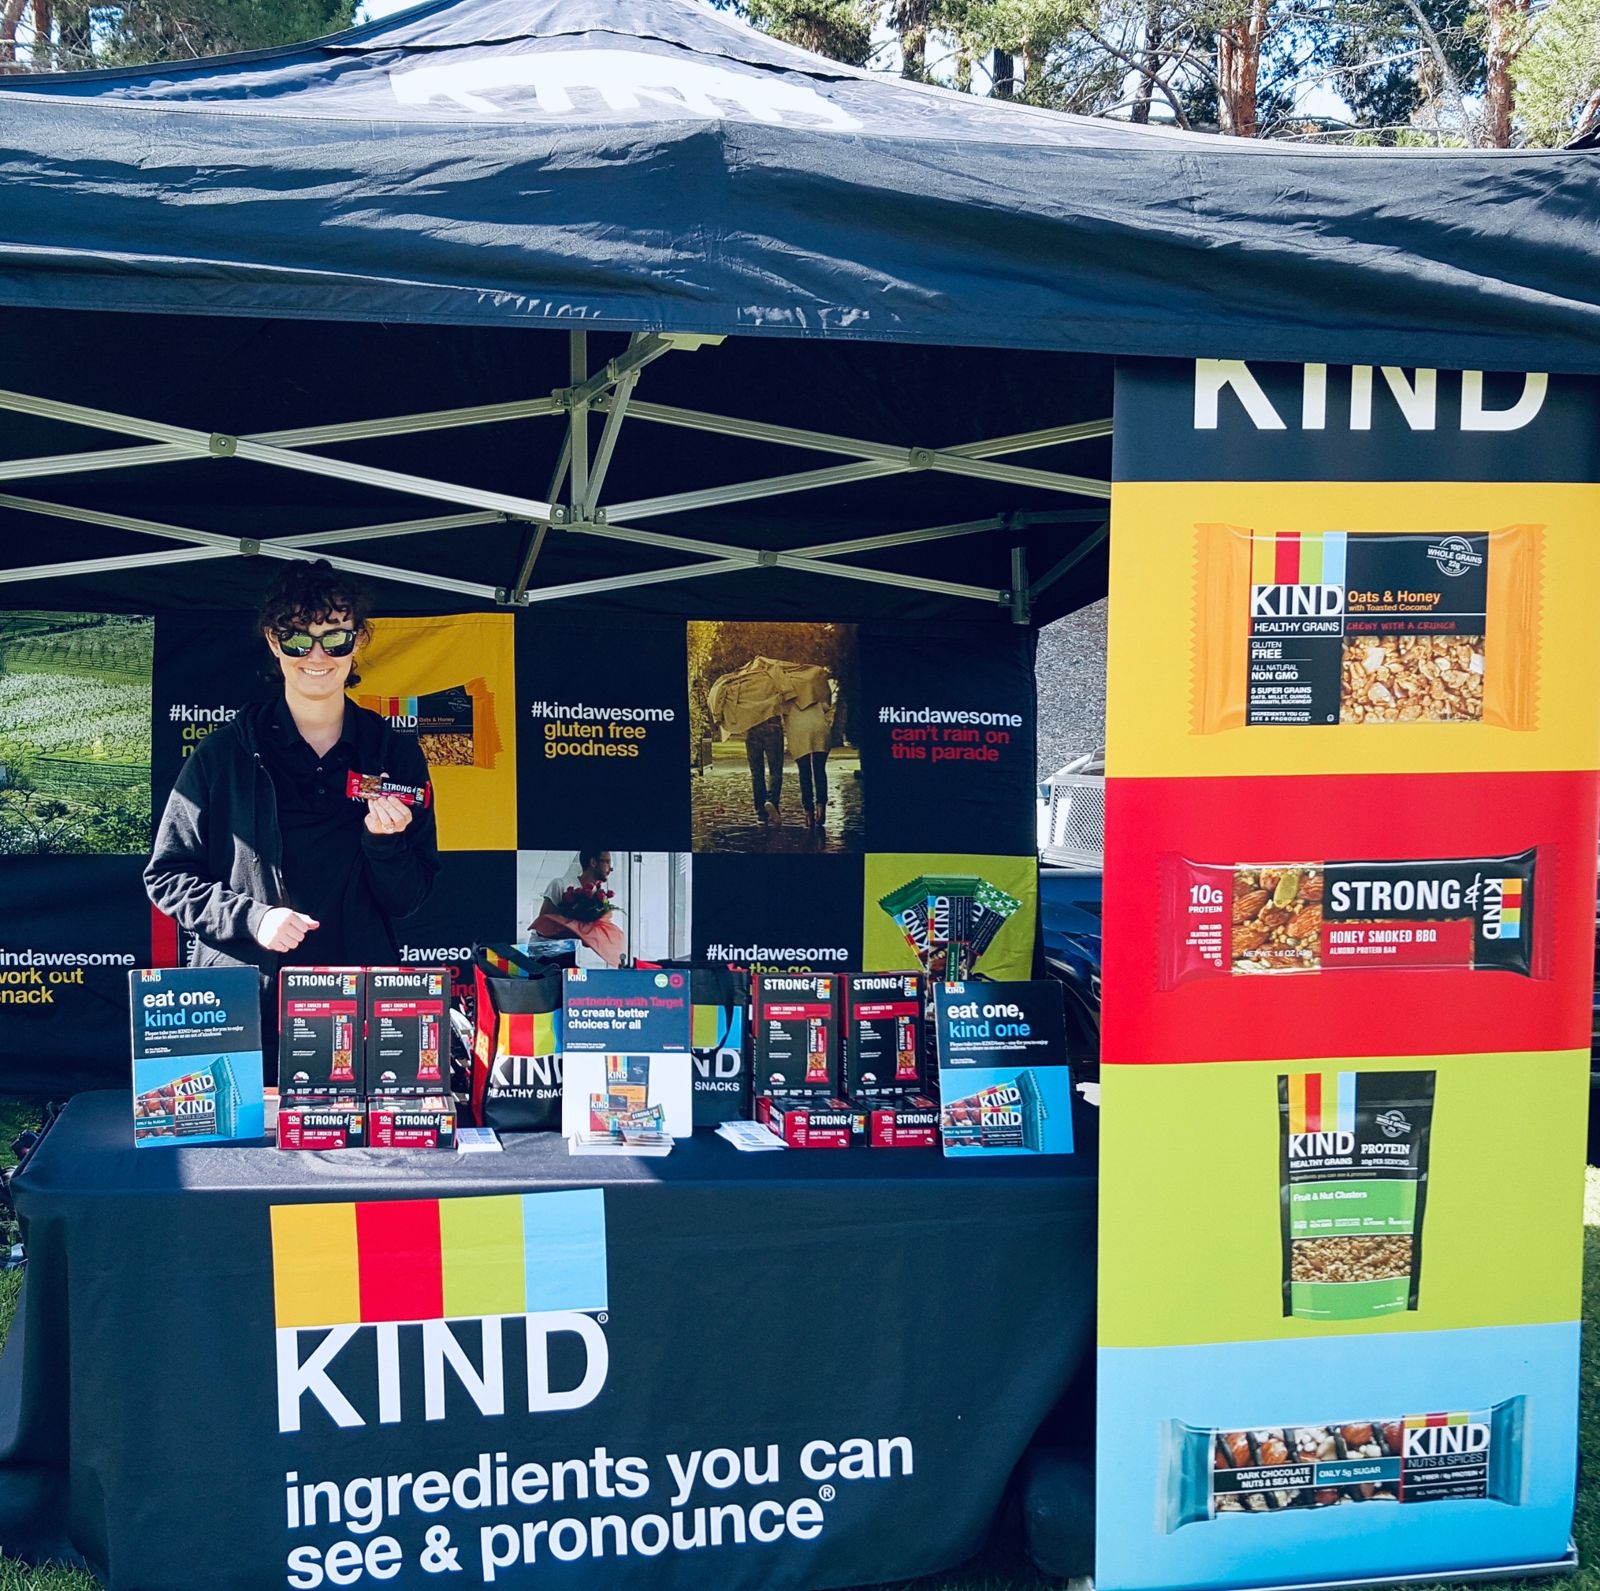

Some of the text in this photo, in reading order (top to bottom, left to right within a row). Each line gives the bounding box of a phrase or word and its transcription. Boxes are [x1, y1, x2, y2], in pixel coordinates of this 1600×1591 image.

[1427, 548, 1483, 564] WHOLE GRAINS
[1251, 584, 1343, 616] KIND
[1347, 590, 1441, 604] Oats & Honey
[1254, 622, 1339, 632] HEALTHY GRAINS
[1382, 622, 1404, 630] WITH
[1417, 621, 1456, 630] CRUNCH
[1252, 649, 1282, 659] FREE
[1251, 671, 1298, 680] NON GMO
[531, 701, 675, 721] #kindawesome
[878, 707, 1023, 727] #kindawesome
[544, 720, 646, 740] gluten free
[891, 725, 1009, 744] can't rain on
[544, 740, 639, 759] goodness
[891, 743, 999, 762] this parade
[382, 782, 411, 793] STRONG
[1190, 884, 1223, 904] 10G
[1330, 872, 1502, 939] STRONG & KIND
[934, 896, 949, 941] KIND
[901, 909, 931, 954] KIND
[1330, 929, 1437, 943] HONEY SMOKED BBQ
[706, 944, 848, 961] #kindawesome
[1356, 946, 1382, 954] PROTEIN
[49, 968, 84, 984] out
[141, 975, 161, 983] KIND
[287, 975, 335, 986] STRONG
[374, 975, 420, 987] STRONG
[567, 974, 587, 982] KIND
[763, 978, 810, 990] STRONG
[853, 977, 896, 991] STRONG
[945, 986, 965, 994] KIND
[0, 986, 54, 1003] nack
[143, 990, 221, 1007] eat one,
[145, 1008, 226, 1027] kind one
[568, 1007, 650, 1018] to create better
[947, 1002, 1024, 1020] eat one,
[568, 1019, 641, 1030] choices for all
[949, 1020, 1030, 1038] kind one
[174, 1074, 213, 1096] KIND
[694, 1081, 740, 1092] SNACKS
[487, 1087, 534, 1098] HEALTHY
[979, 1087, 1020, 1107] KIND
[176, 1099, 215, 1115] KIND
[304, 1115, 343, 1125] STRONG
[395, 1115, 434, 1125] STRONG
[809, 1116, 846, 1125] STRONG
[896, 1114, 933, 1124] STRONG
[981, 1111, 1022, 1126] KIND
[1288, 1131, 1355, 1158] KIND
[1361, 1144, 1410, 1155] PROTEIN
[1290, 1158, 1353, 1168] HEALTHY GRAINS
[1293, 1193, 1311, 1202] Fruit
[1320, 1192, 1334, 1200] Nut
[1335, 1191, 1367, 1199] Clusters
[1403, 1424, 1491, 1458] KIND
[1408, 1453, 1484, 1468] NUTS & SPICES
[1236, 1467, 1310, 1480] DARK CHOCOLATE
[1319, 1466, 1381, 1478] ONLY 5g SUGAR
[286, 1434, 913, 1534] ingredients you can
[1241, 1479, 1264, 1488] NUTS
[1272, 1478, 1288, 1486] SEA
[1290, 1476, 1310, 1485] SALT
[287, 1533, 402, 1590] see
[419, 1524, 462, 1574] &
